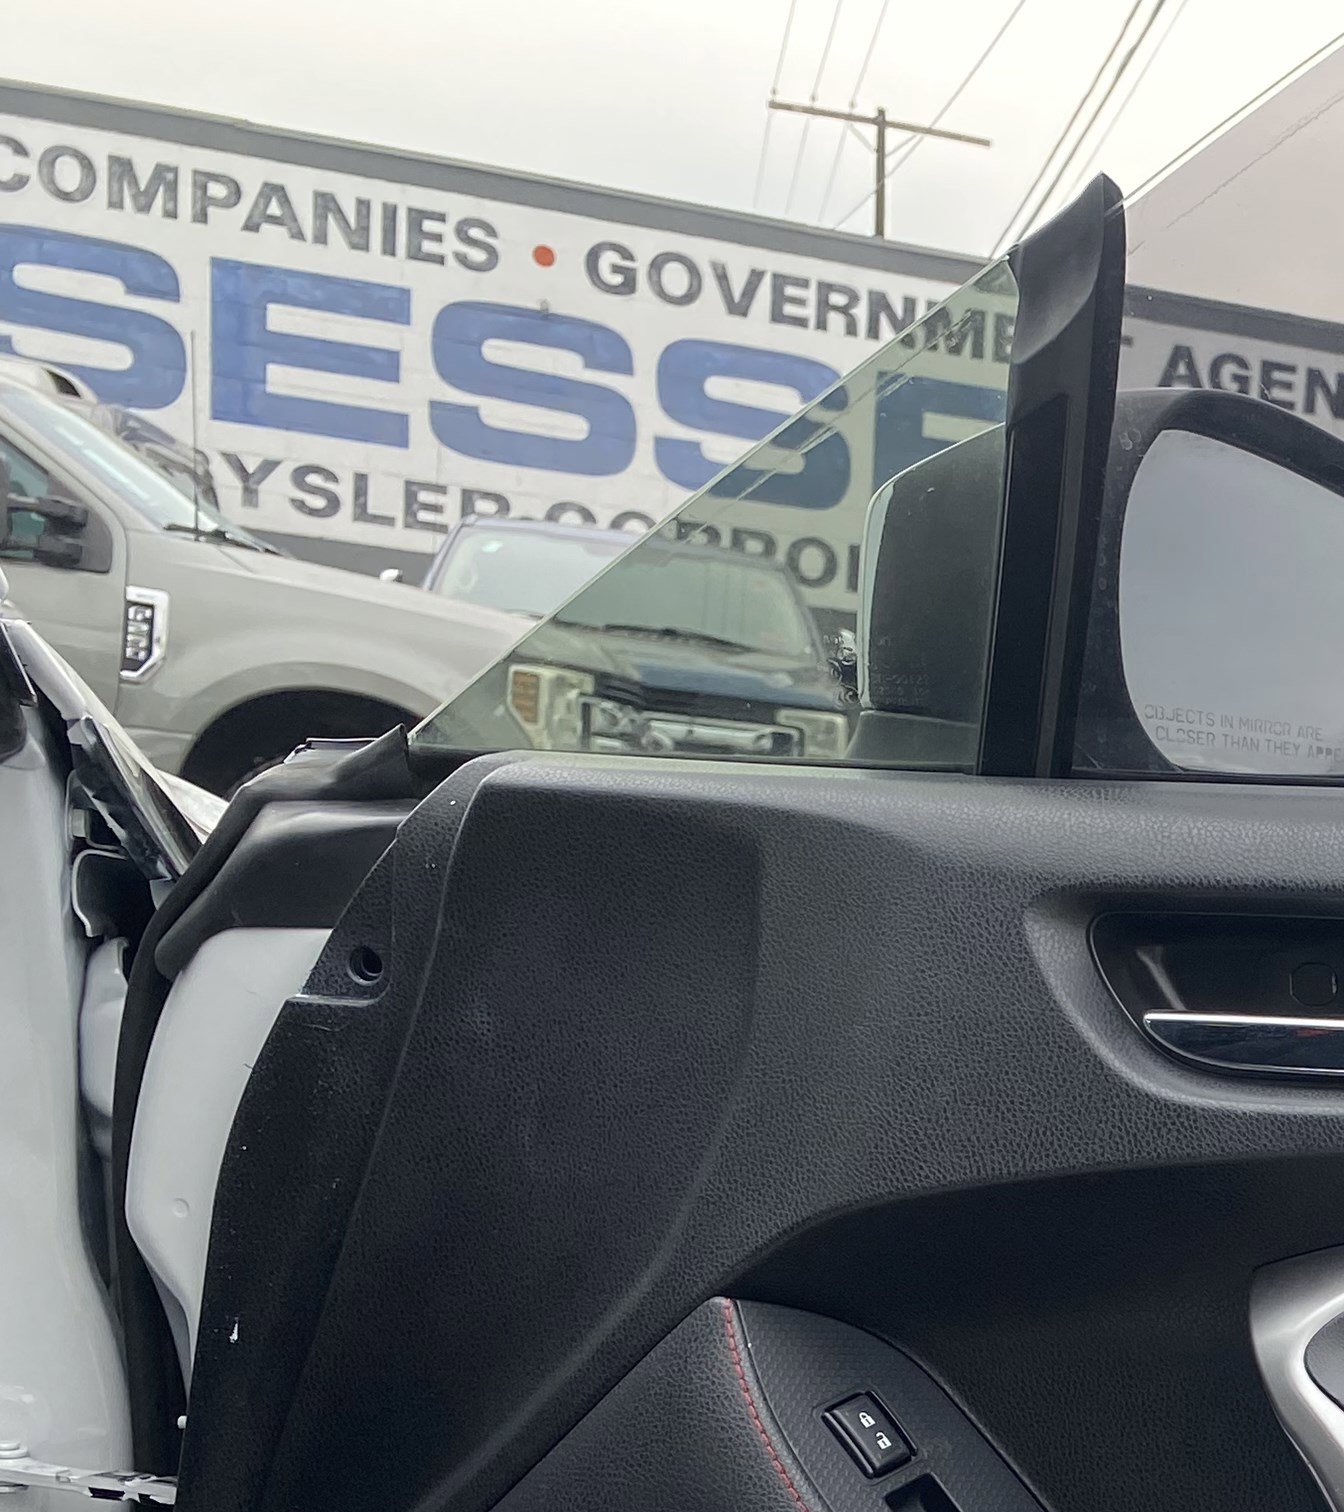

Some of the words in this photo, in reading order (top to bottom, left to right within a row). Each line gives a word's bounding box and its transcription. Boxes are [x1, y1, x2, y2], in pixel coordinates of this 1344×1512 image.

[584, 240, 1016, 366] GOVERNM
[1144, 703, 1216, 727] OBJECTS
[1220, 713, 1234, 730] IN
[1238, 717, 1291, 737] MIRROR
[1297, 723, 1323, 742] ARE
[1156, 724, 1216, 748] CLOSER
[1222, 734, 1261, 753] THAN
[1266, 739, 1300, 757] THEY
